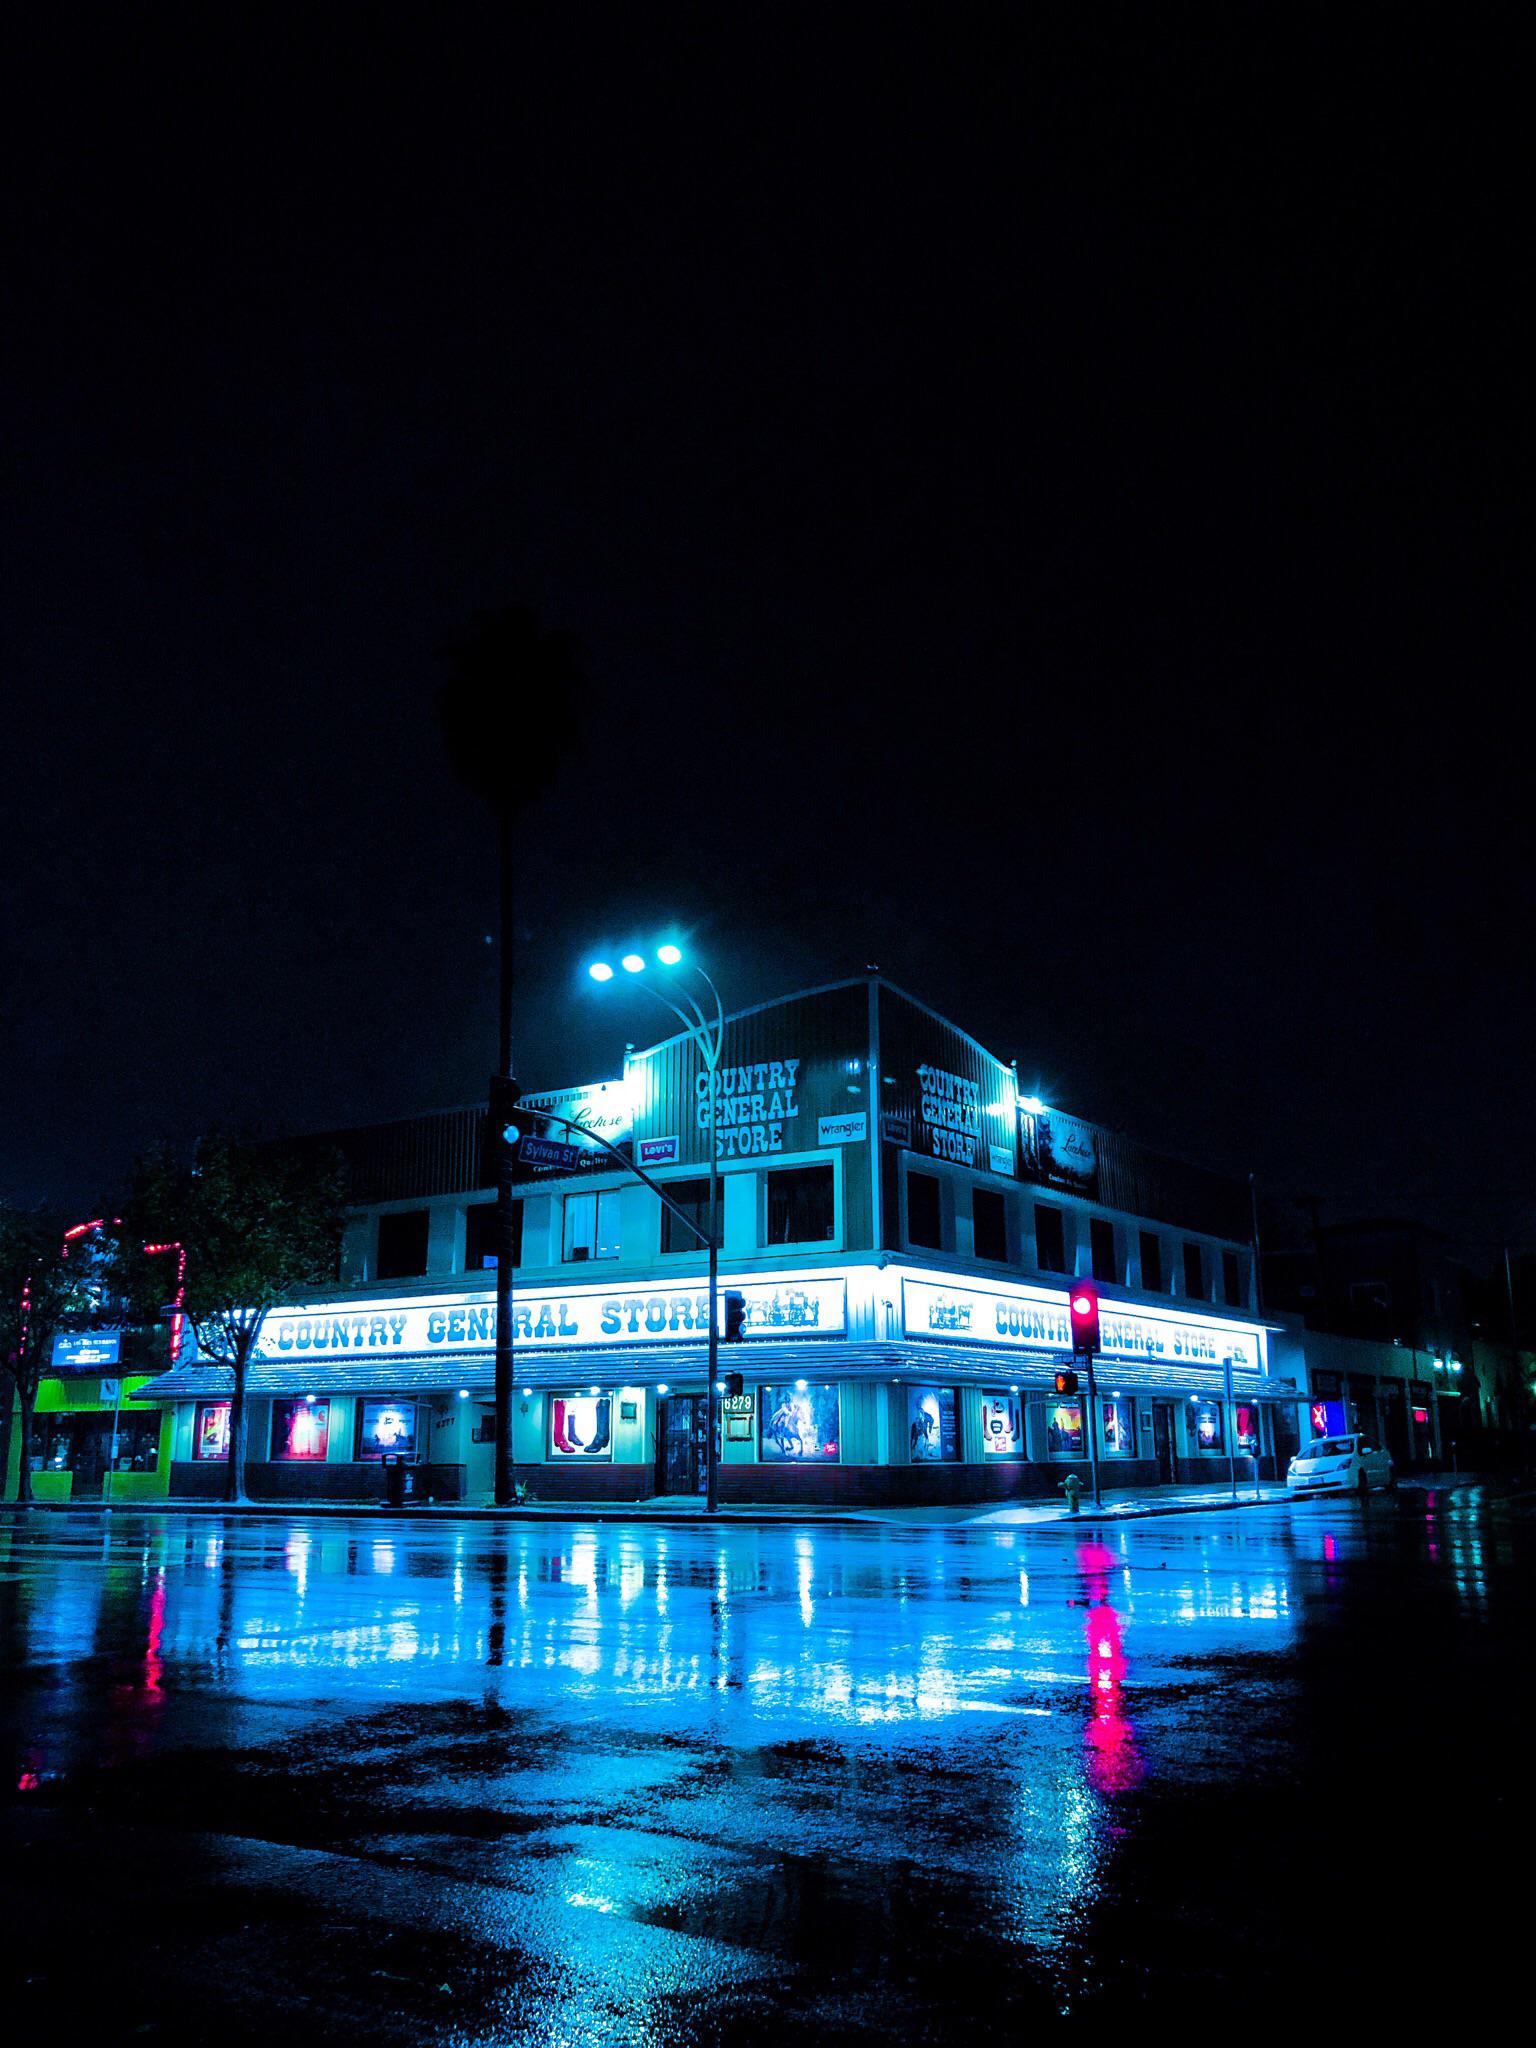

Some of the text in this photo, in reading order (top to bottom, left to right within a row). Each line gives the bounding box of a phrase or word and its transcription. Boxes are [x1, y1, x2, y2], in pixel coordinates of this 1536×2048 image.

[920, 1064, 979, 1108] COUNTRY
[820, 1121, 865, 1137] Wrangler
[922, 1094, 981, 1138] GENERAL
[526, 1142, 574, 1163] Sylvan St
[714, 1122, 783, 1158] STORE
[278, 1314, 407, 1350] COUNTRY
[600, 1295, 710, 1334] STORE
[995, 1301, 1216, 1359] COUNTR ENERAL STORE
[724, 1395, 752, 1410] 6279
